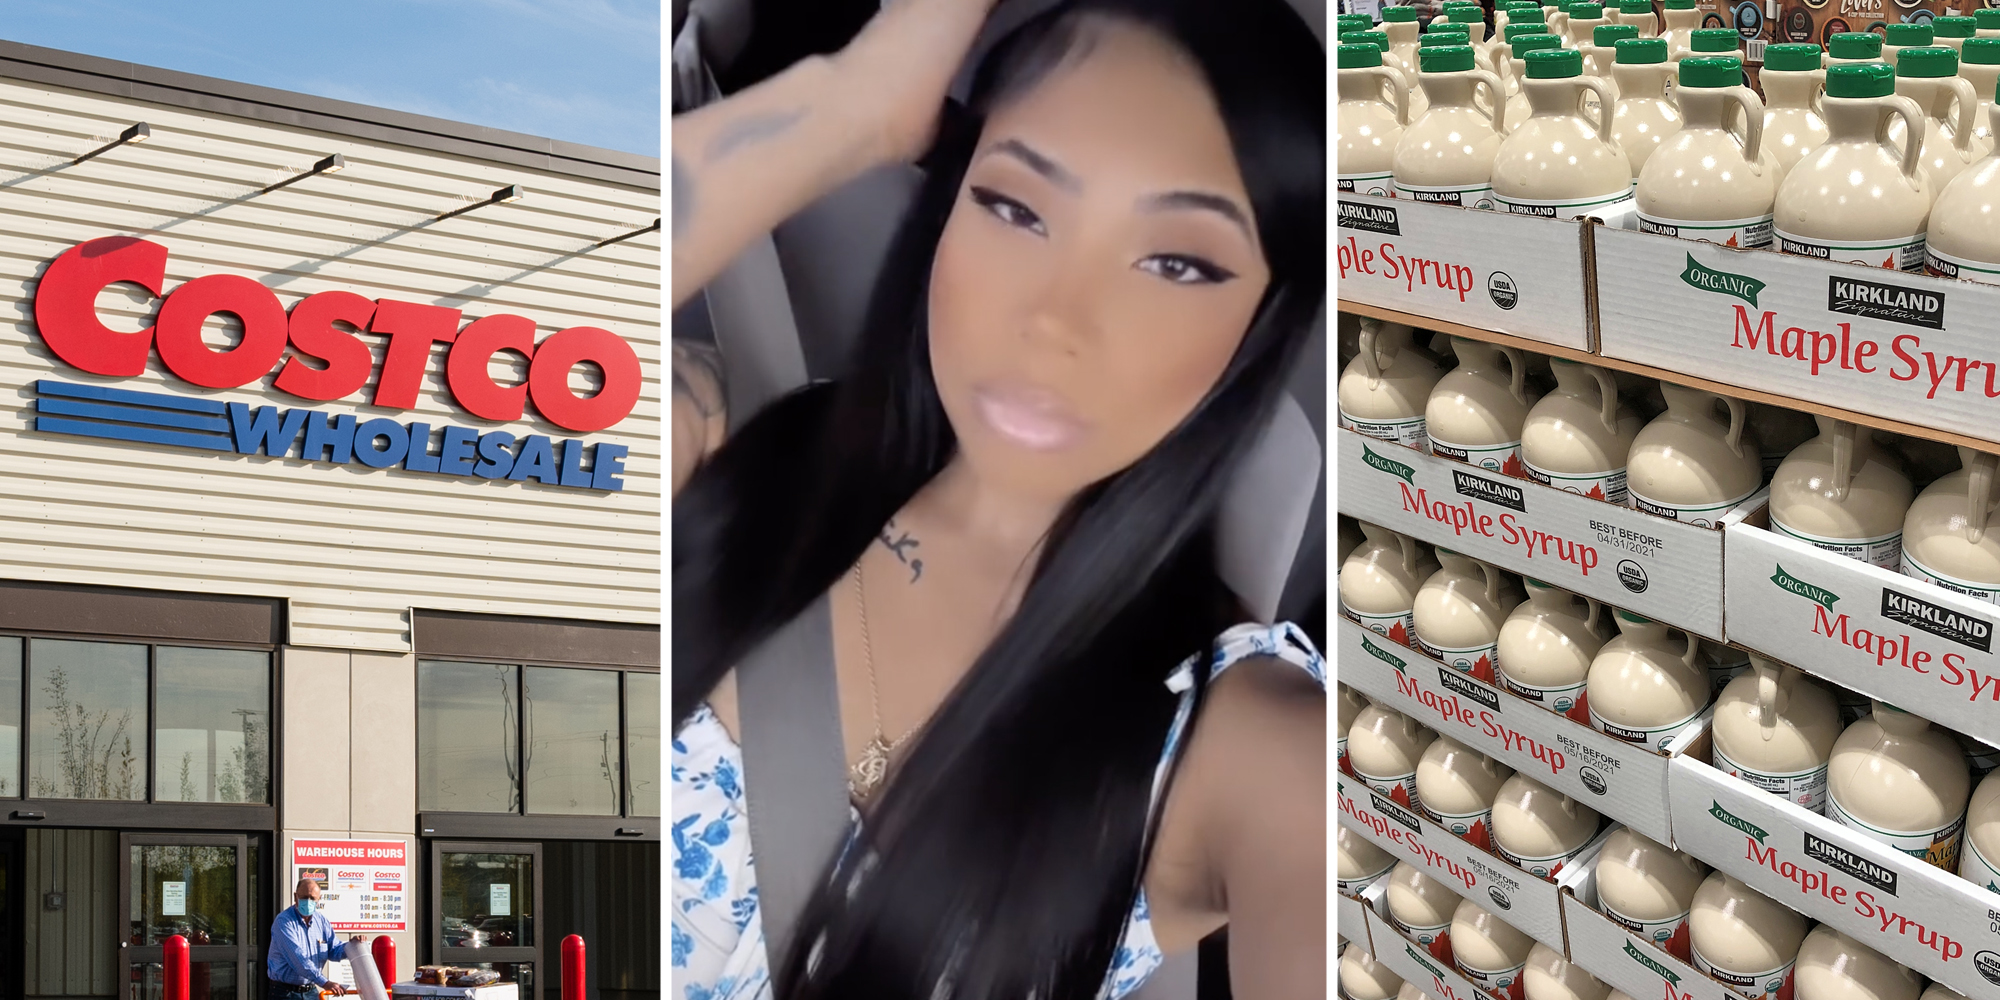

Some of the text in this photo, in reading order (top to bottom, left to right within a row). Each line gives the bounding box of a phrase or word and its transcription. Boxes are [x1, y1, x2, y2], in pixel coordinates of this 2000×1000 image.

[1416, 192, 1459, 201] KIRKLAND
[1338, 204, 1395, 223] KIRKLAND
[1510, 204, 1554, 216] KIRKLAND
[1339, 216, 1397, 230] Signature
[1640, 219, 1676, 236] KIRKLAND
[1745, 224, 1768, 234] Nutrition
[1783, 240, 1828, 257] KIRKLAND
[1902, 244, 1925, 255] Nutrition
[1338, 236, 1474, 302] ple Syrup
[1493, 279, 1511, 291] USDA
[1690, 267, 1754, 298] ORGANIC
[1493, 290, 1514, 301] ORGANIC
[1835, 281, 1939, 313] KIRKLAND
[1834, 300, 1938, 323] Signature
[34, 235, 642, 432] COSTCO
[1730, 304, 2000, 399] Maple Syru
[228, 402, 629, 492] WHOLESALE
[1434, 442, 1467, 457] KIRKLAND
[1367, 453, 1409, 479] ORGANIC
[1607, 474, 1627, 483] Nutritio
[1457, 473, 1521, 501] KIRKLAND
[1459, 486, 1523, 508] Signature
[1637, 499, 1676, 517] KIRKLAND
[1398, 481, 1598, 576] Maple Syrup
[1589, 520, 1663, 550] BEST BEFORE
[1597, 532, 1655, 559] 04/31/2021
[1814, 541, 1843, 552] Nutrition
[1623, 566, 1641, 578] USDA
[1778, 575, 1831, 605] ORGANIC
[1936, 580, 1989, 598] Nutrition Facts
[1886, 608, 1986, 647] Signature
[1887, 593, 1988, 638] KIRKLAND
[1811, 603, 1932, 674] Maple
[1366, 642, 1402, 668] ORGANIC
[1441, 671, 1497, 703] KIRKLAND
[1507, 680, 1542, 697] KIRKLAND
[1392, 668, 1566, 774] Maple Syrup
[1605, 724, 1645, 739] KIRKLAND
[1556, 733, 1621, 769] BEST BEFORE
[1564, 745, 1614, 775] 05/16/2021
[1584, 771, 1601, 783] USDA
[1743, 773, 1767, 783] Nutrition
[1373, 797, 1418, 828] KIRKLAND
[1715, 809, 1761, 839] ORGANIC
[1338, 790, 1476, 889] Maple Syrup
[1928, 840, 1959, 864] Map
[296, 847, 404, 858] WAREHOUSE HOURS
[1809, 837, 1893, 884] KIRKLAND
[302, 871, 326, 879] COSTCO
[337, 870, 364, 878] COSTCO
[1466, 856, 1520, 890] BEST BEFORE
[1808, 850, 1893, 892] Signature
[1745, 836, 1963, 962] Maple Syrup
[1607, 910, 1642, 929] KIRKLAND
[1629, 948, 1674, 980] ORGANIC
[1712, 968, 1753, 983] KIRKLAND
